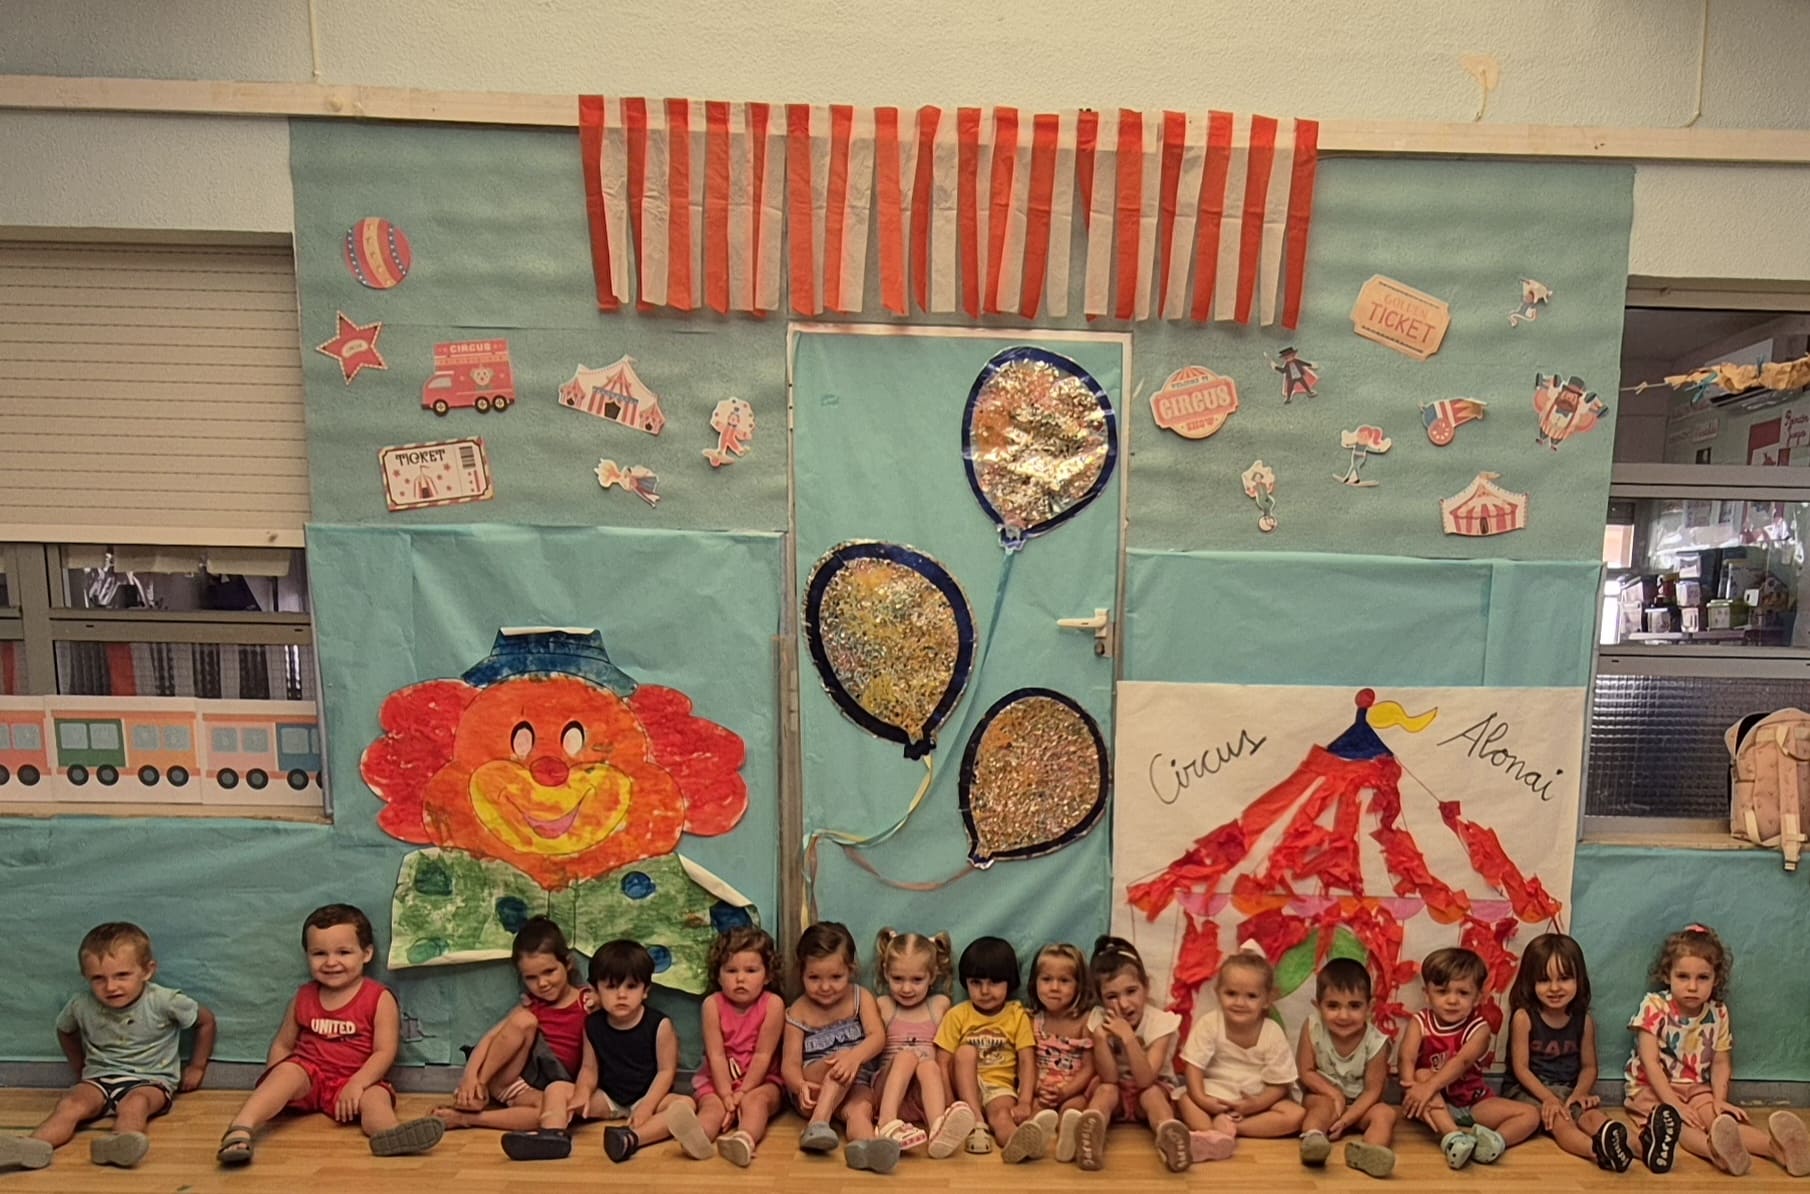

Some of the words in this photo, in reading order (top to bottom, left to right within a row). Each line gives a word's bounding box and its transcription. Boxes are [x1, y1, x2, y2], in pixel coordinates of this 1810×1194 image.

[1369, 301, 1436, 343] TICKET
[449, 342, 491, 353] CIRCUS
[1159, 385, 1231, 419] CIRCUS
[395, 448, 446, 466] TICKET
[1149, 729, 1267, 805] Circus
[311, 1018, 356, 1035] UNITED
[1656, 1110, 1675, 1167] garvalin
